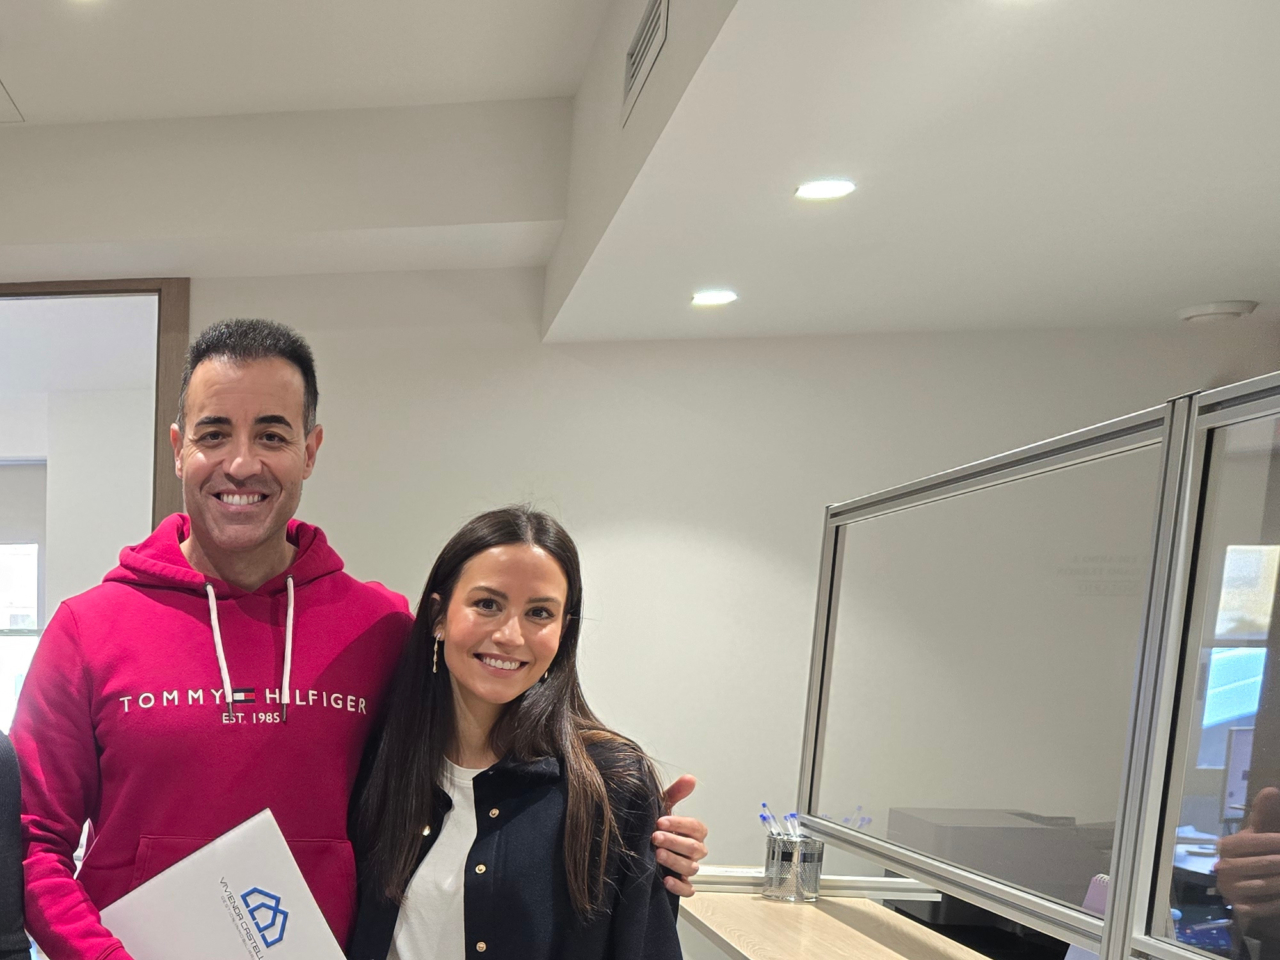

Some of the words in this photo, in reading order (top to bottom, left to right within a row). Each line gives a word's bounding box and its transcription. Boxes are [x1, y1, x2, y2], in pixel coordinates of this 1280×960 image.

[120, 689, 223, 712] TOMMY
[265, 688, 367, 715] HLFIGER
[252, 712, 280, 724] 1985
[220, 877, 244, 921] VIVIENDA
